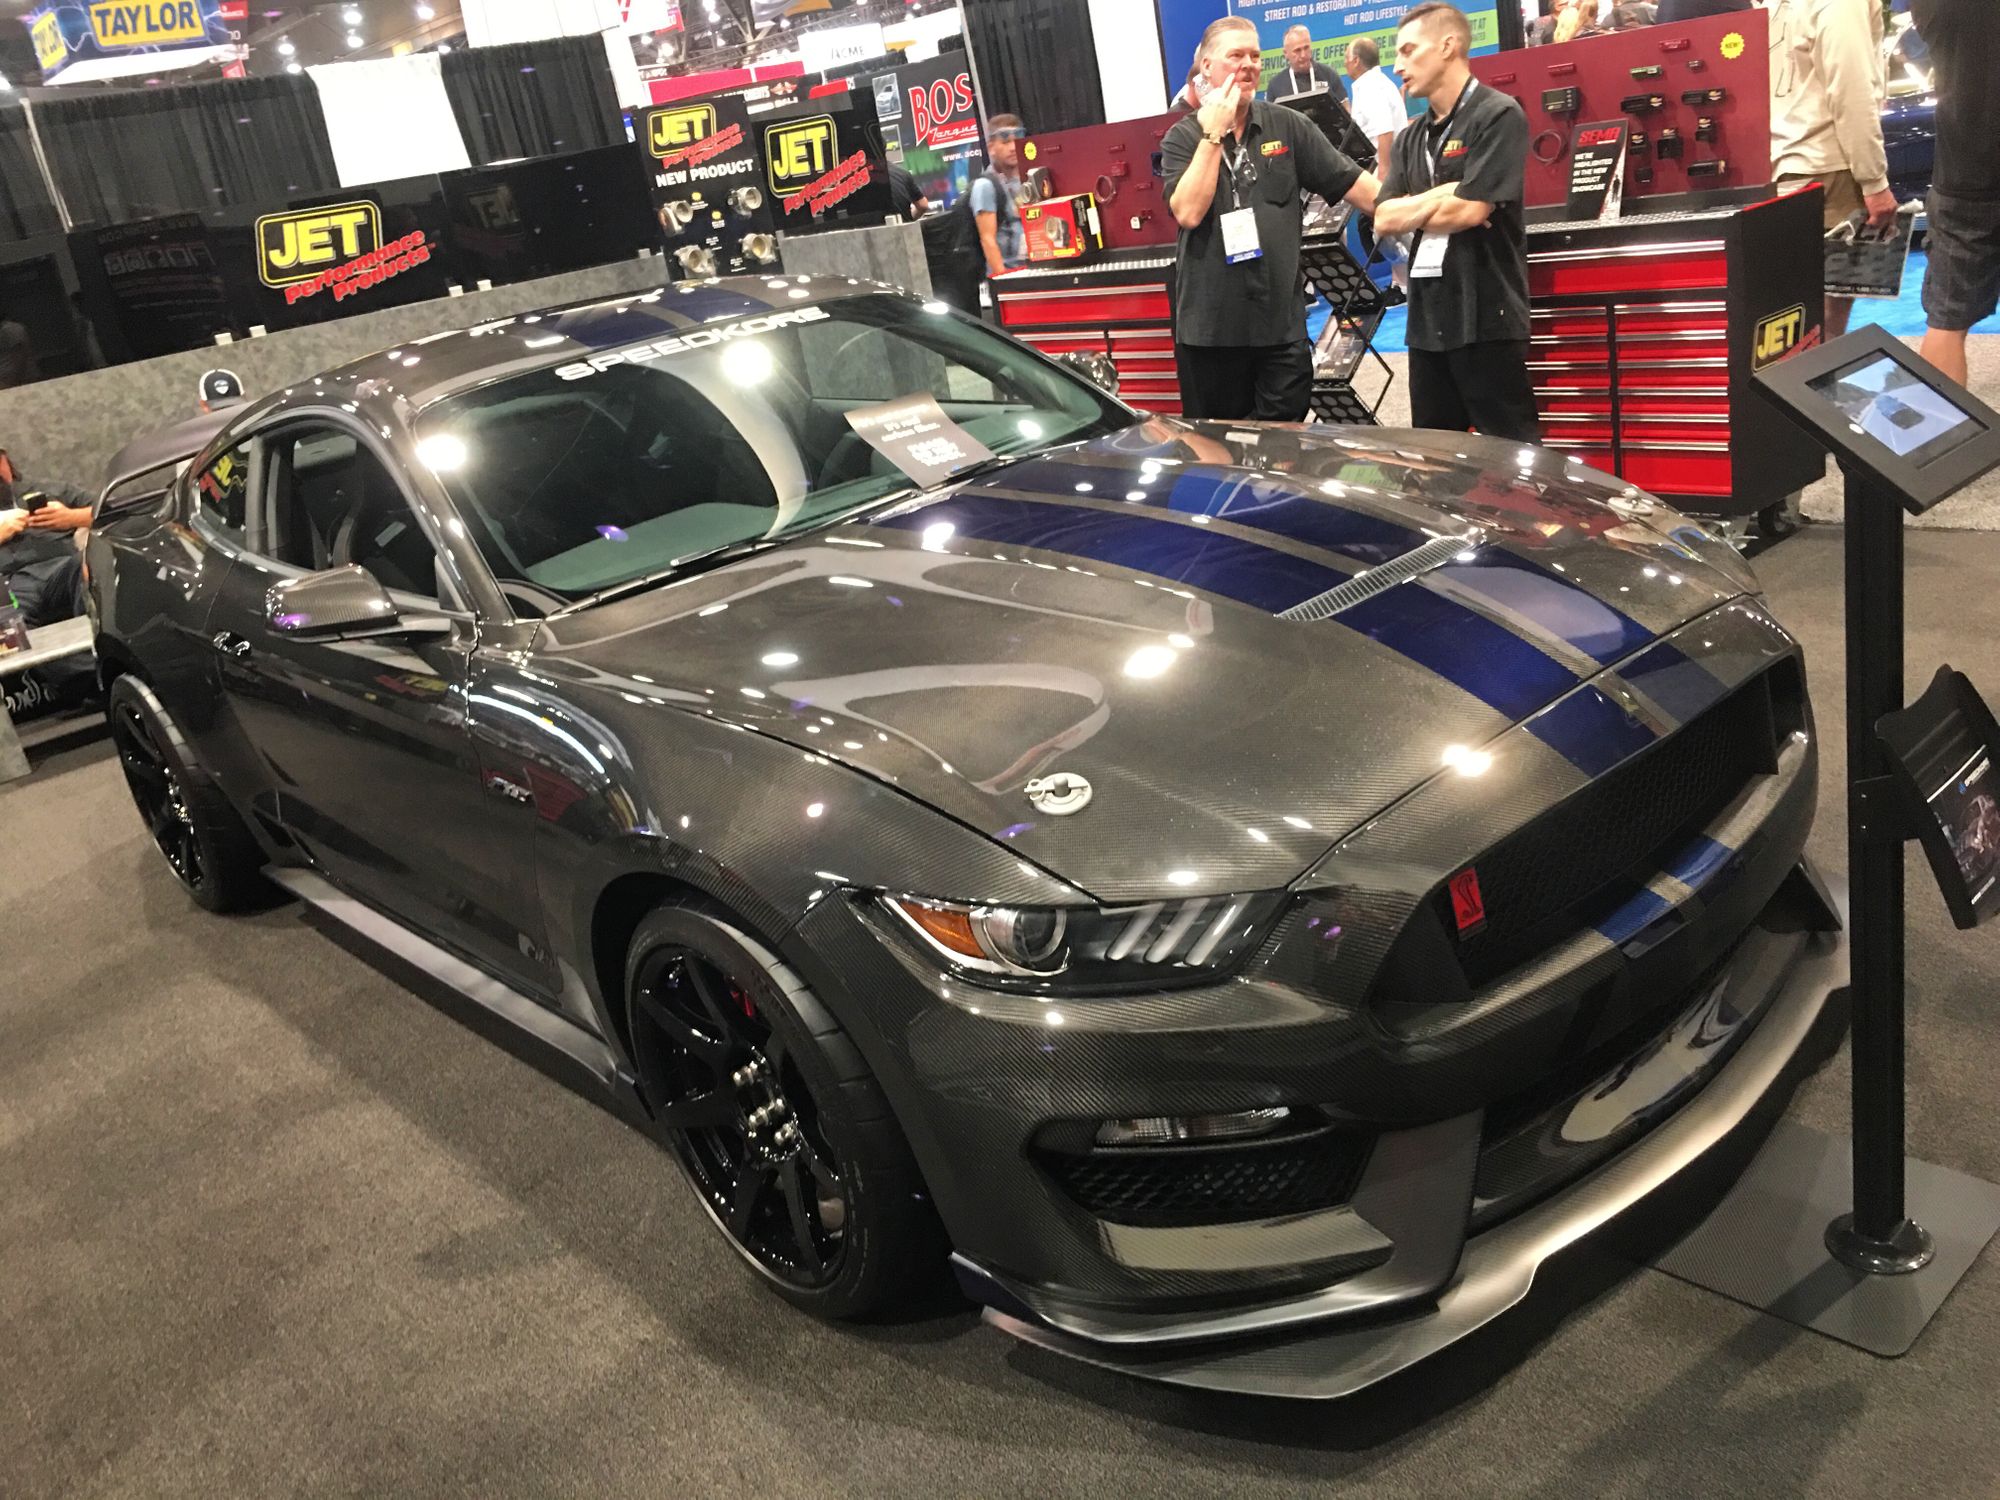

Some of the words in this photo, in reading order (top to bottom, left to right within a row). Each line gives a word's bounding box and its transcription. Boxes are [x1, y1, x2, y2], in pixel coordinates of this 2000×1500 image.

[95, 1, 198, 37] TAYLOR
[1264, 7, 1291, 22] STREET
[1343, 13, 1358, 25] HOT
[1376, 5, 1408, 20] LIFESTYLE
[653, 109, 709, 147] JET
[773, 125, 829, 180] JET
[655, 170, 687, 188] NEW
[689, 159, 754, 182] PRODUCT
[1025, 207, 1042, 220] JET
[268, 211, 368, 269] JET
[555, 306, 831, 381] SPEEDKORE
[1756, 311, 1800, 361] JET
